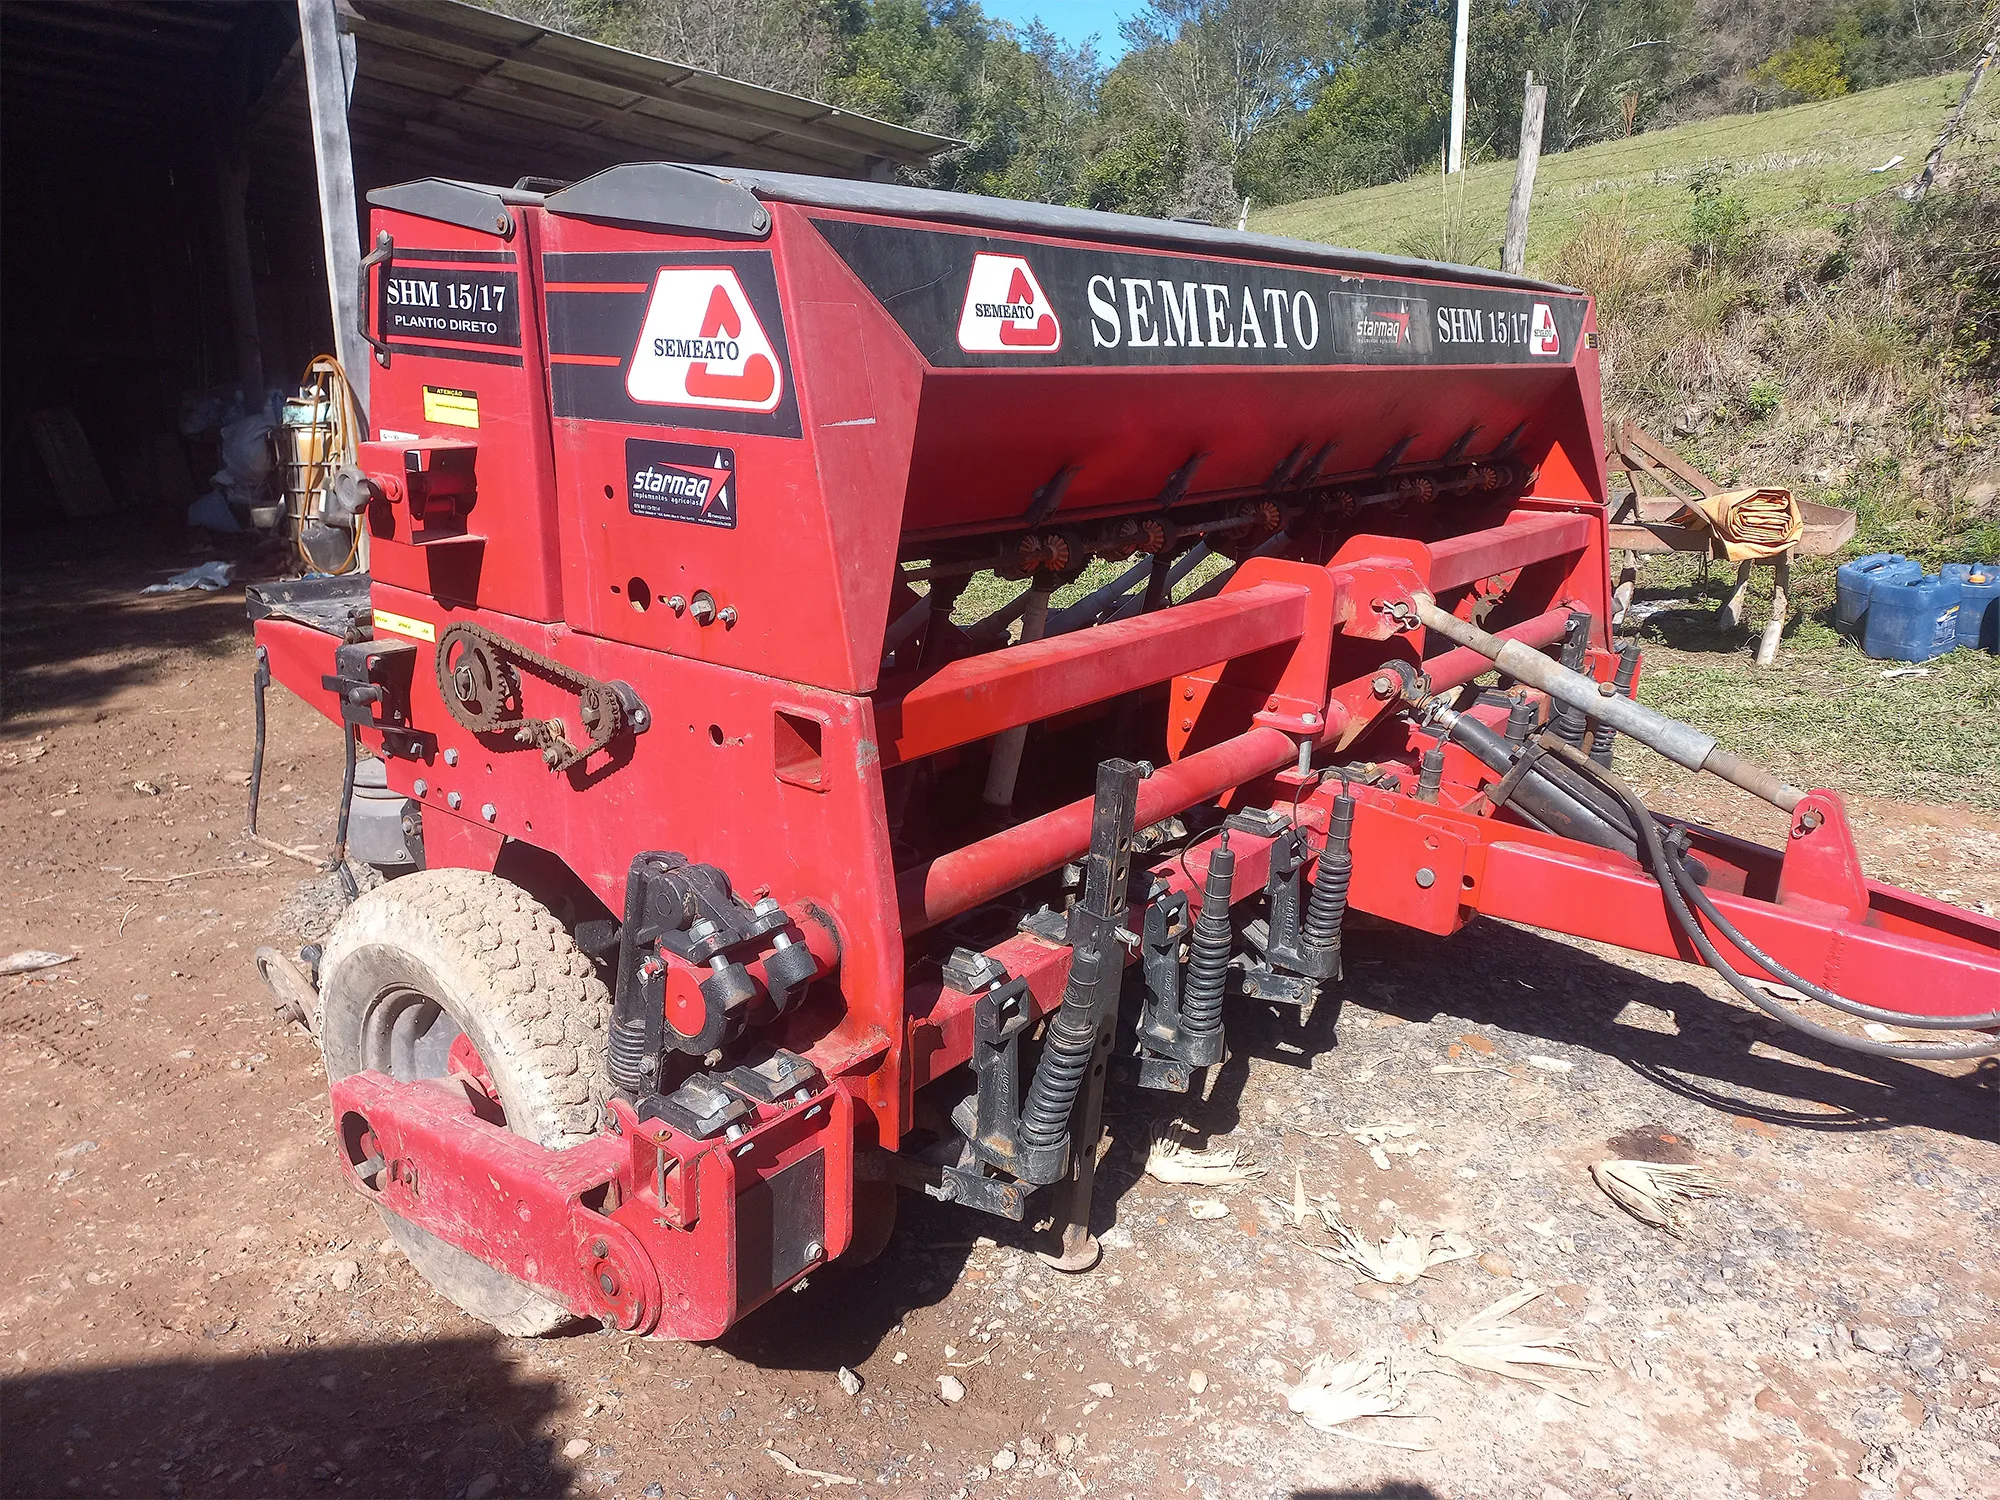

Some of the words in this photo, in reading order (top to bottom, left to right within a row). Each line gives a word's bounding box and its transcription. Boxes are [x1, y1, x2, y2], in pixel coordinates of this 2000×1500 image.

[387, 279, 440, 308] SHM
[447, 283, 506, 313] 15/17
[975, 303, 1034, 319] SEMEATO
[394, 314, 447, 330] PLANTIO
[449, 319, 498, 334] DIRETO
[1087, 274, 1319, 350] SEMEATO
[1437, 306, 1484, 343] SHM
[1488, 311, 1528, 347] 15/17
[1356, 316, 1400, 343] starmaq
[654, 338, 739, 360] SEMEATO
[632, 466, 710, 506] starmaq
